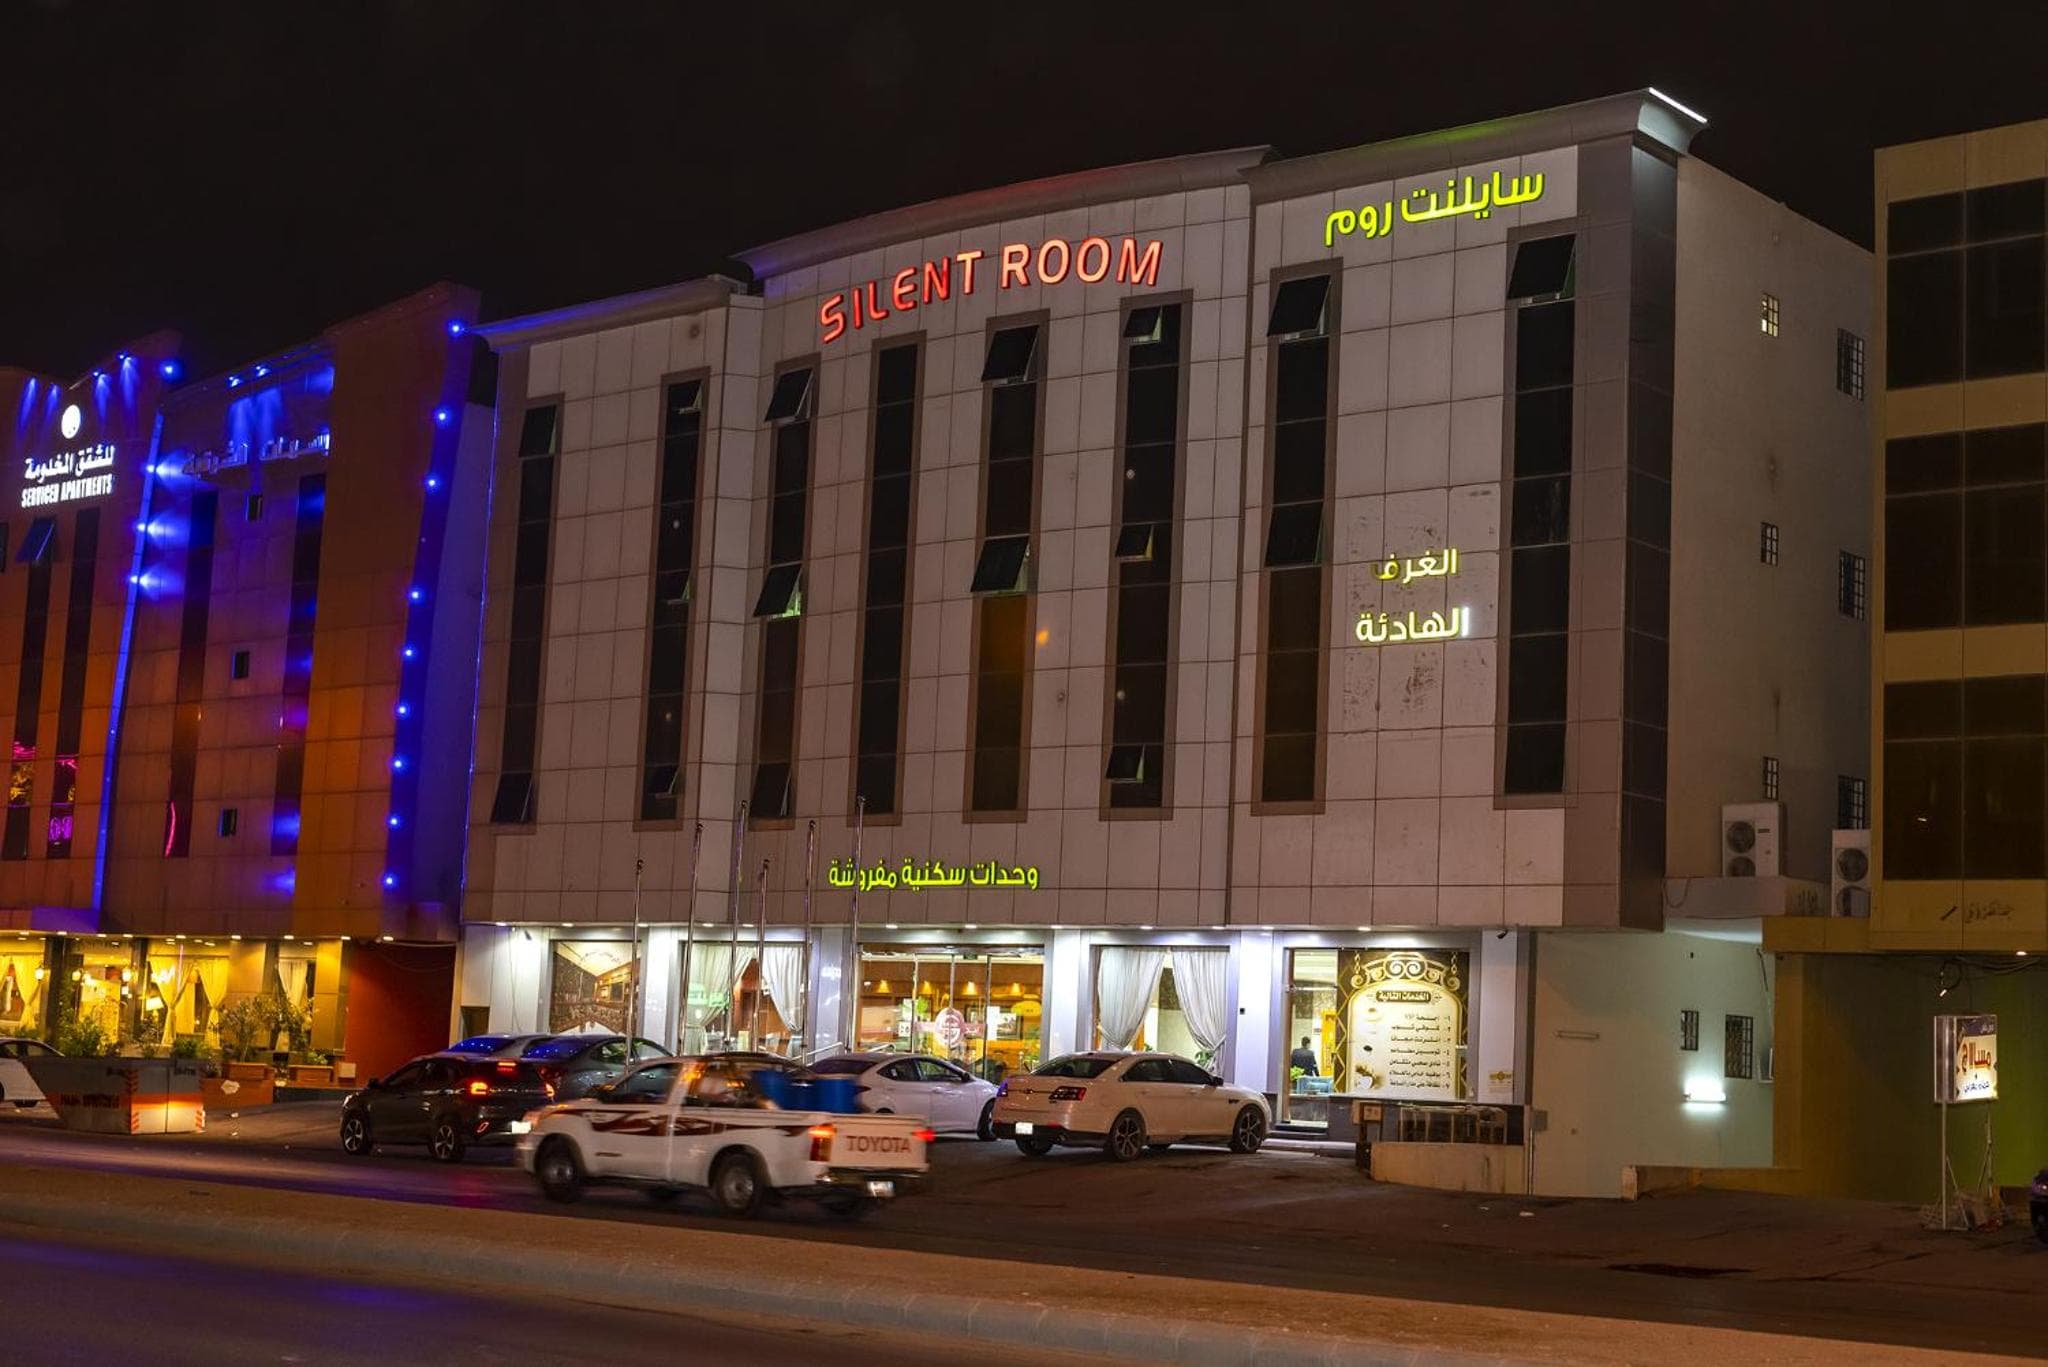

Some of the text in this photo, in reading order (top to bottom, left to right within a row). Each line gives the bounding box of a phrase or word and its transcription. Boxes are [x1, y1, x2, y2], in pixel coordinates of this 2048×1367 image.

[1325, 171, 1545, 247] سايلنت روم
[819, 237, 1163, 344] SILENT ROOM
[60, 473, 113, 501] APARTMENTS
[1370, 548, 1458, 584] الغرف
[1356, 606, 1470, 643] الهادئة
[828, 858, 1039, 891] وحدات سكنية مفروشة
[846, 1135, 912, 1153] TOYOTA
